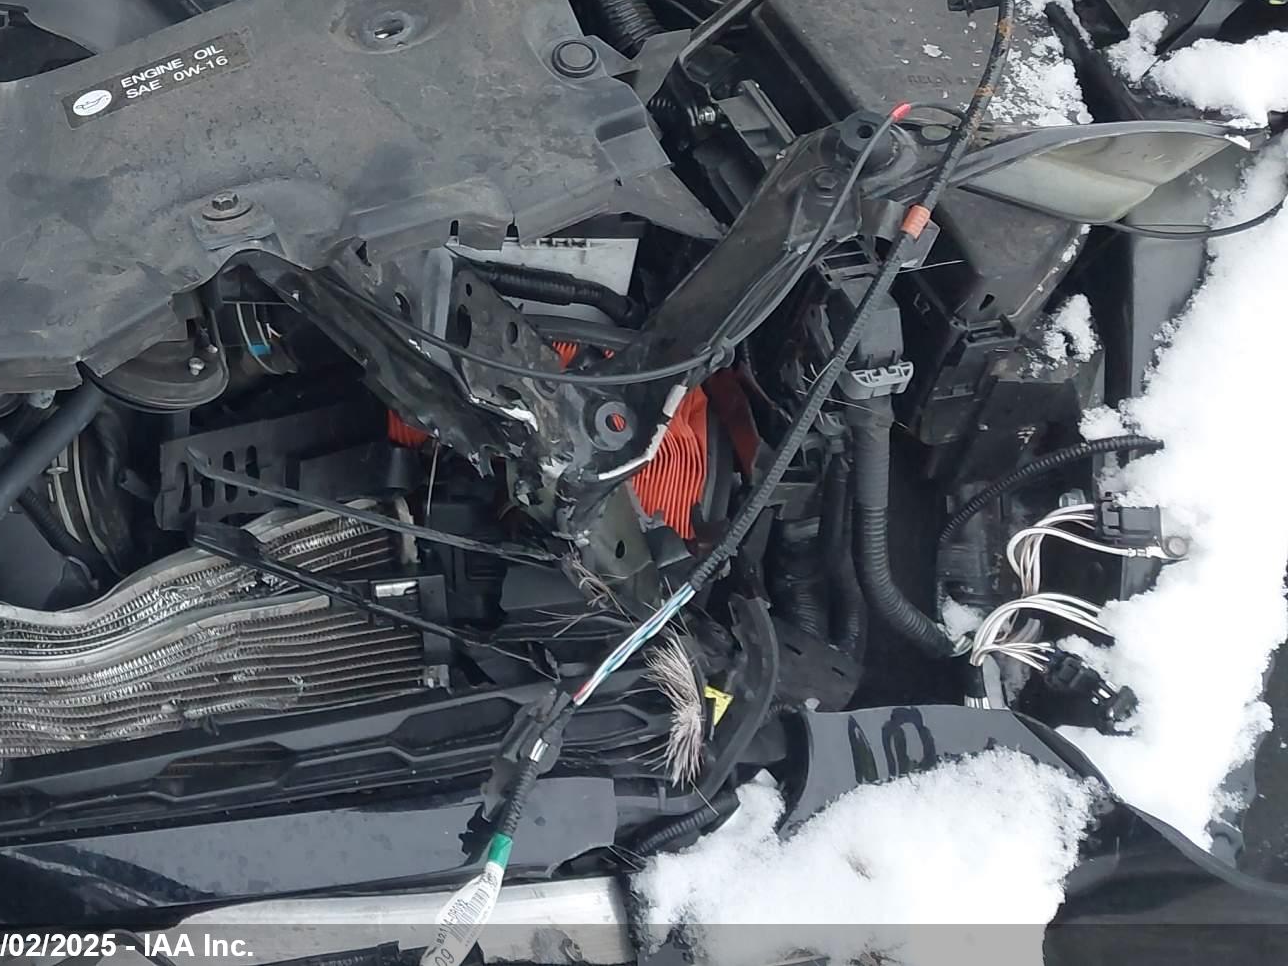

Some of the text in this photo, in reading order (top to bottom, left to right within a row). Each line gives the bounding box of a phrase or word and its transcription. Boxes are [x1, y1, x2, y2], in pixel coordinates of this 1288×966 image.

[121, 45, 224, 88] ENGINE OIL
[126, 55, 229, 99] SAE 0W-16
